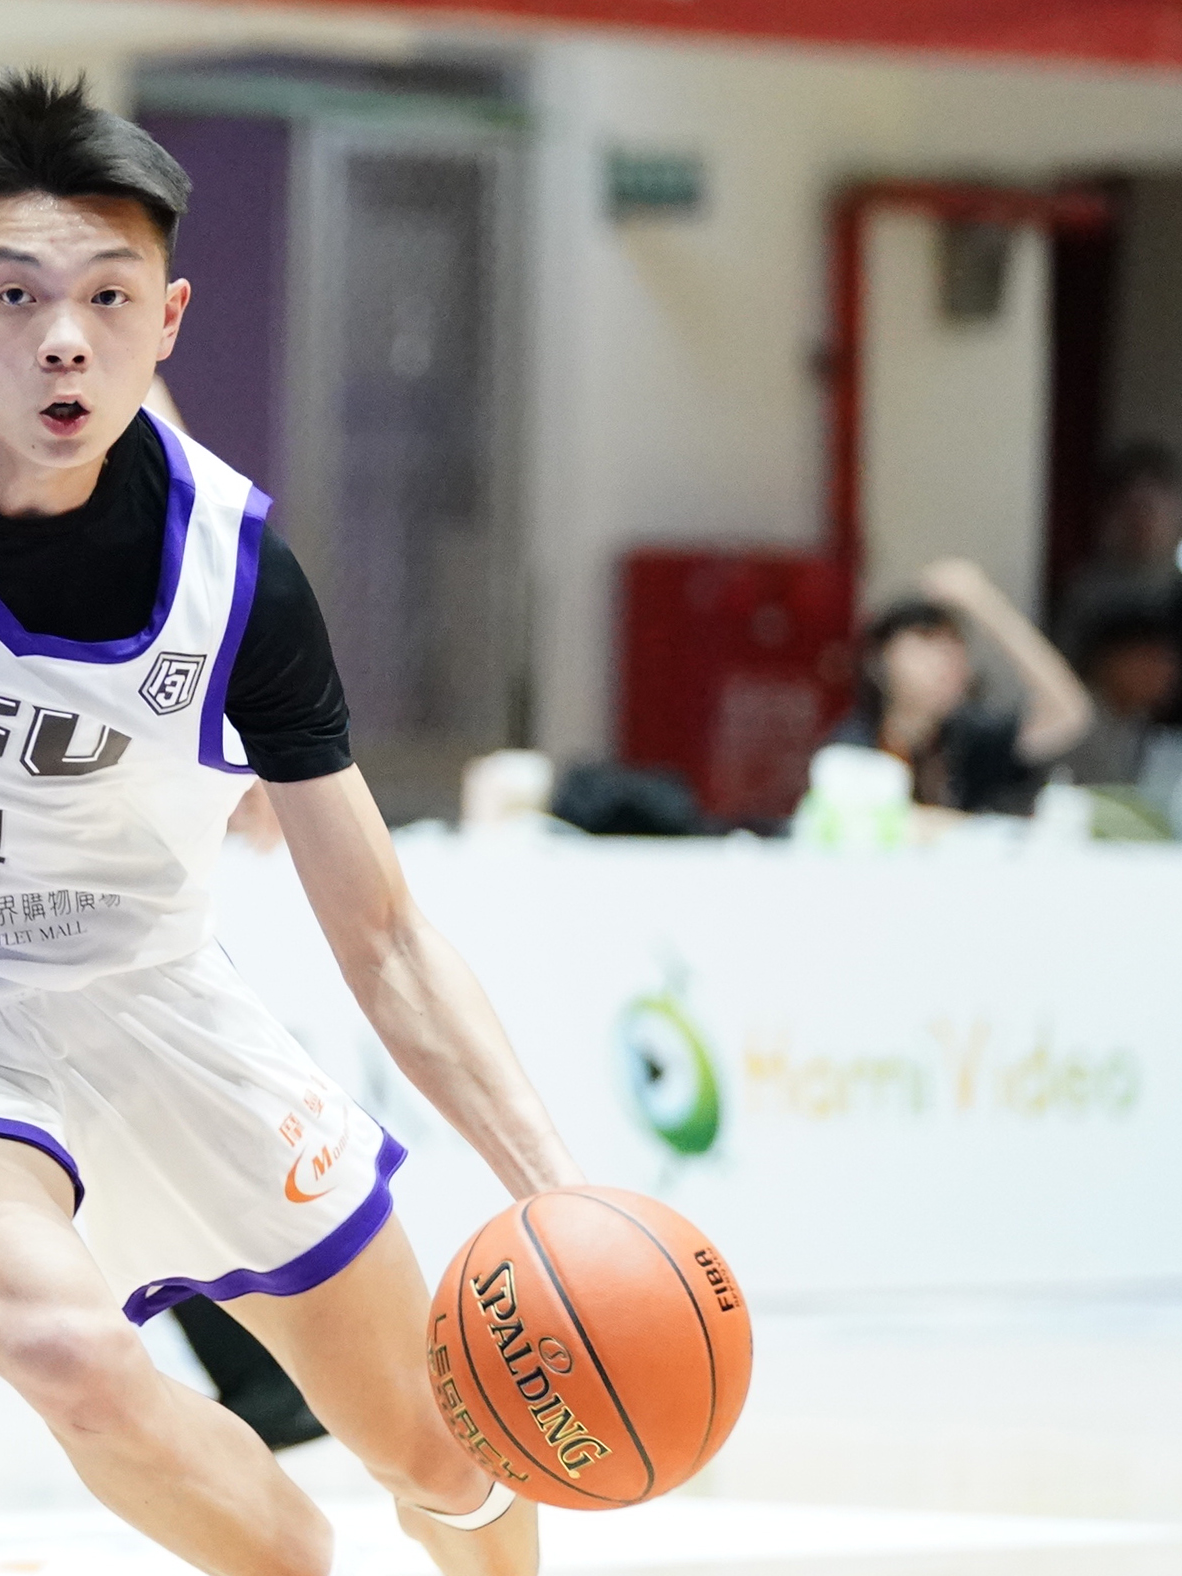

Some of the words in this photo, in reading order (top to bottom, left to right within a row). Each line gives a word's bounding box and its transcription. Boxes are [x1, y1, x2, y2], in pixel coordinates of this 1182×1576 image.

[40, 920, 89, 942] MALL
[694, 1250, 734, 1312] FIBA
[433, 1313, 530, 1482] LEGACY
[469, 1260, 613, 1478] SPALDING
